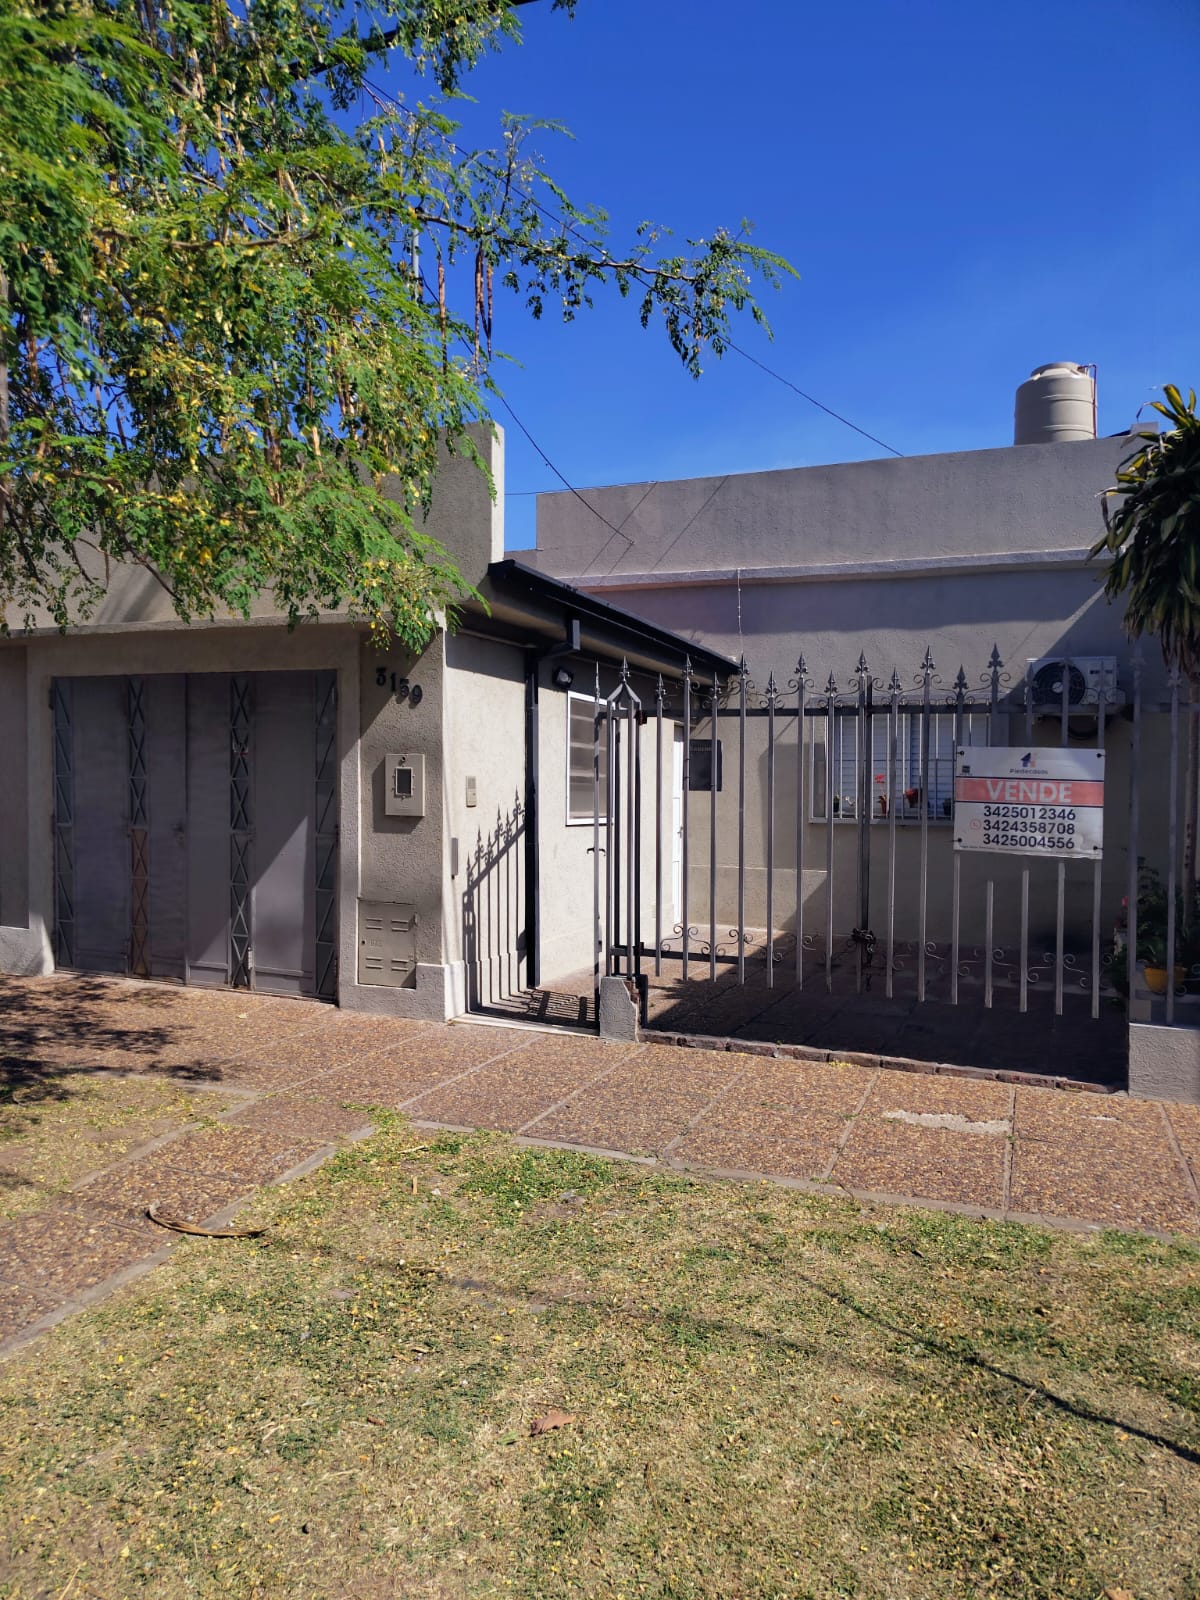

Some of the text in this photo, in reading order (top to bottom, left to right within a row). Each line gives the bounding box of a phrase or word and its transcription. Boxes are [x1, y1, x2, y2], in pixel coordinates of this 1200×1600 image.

[986, 781, 1072, 803] VENDE
[983, 805, 1076, 821] 3425012346
[983, 819, 1075, 835] 3424358708
[982, 833, 1075, 849] 3425004556
